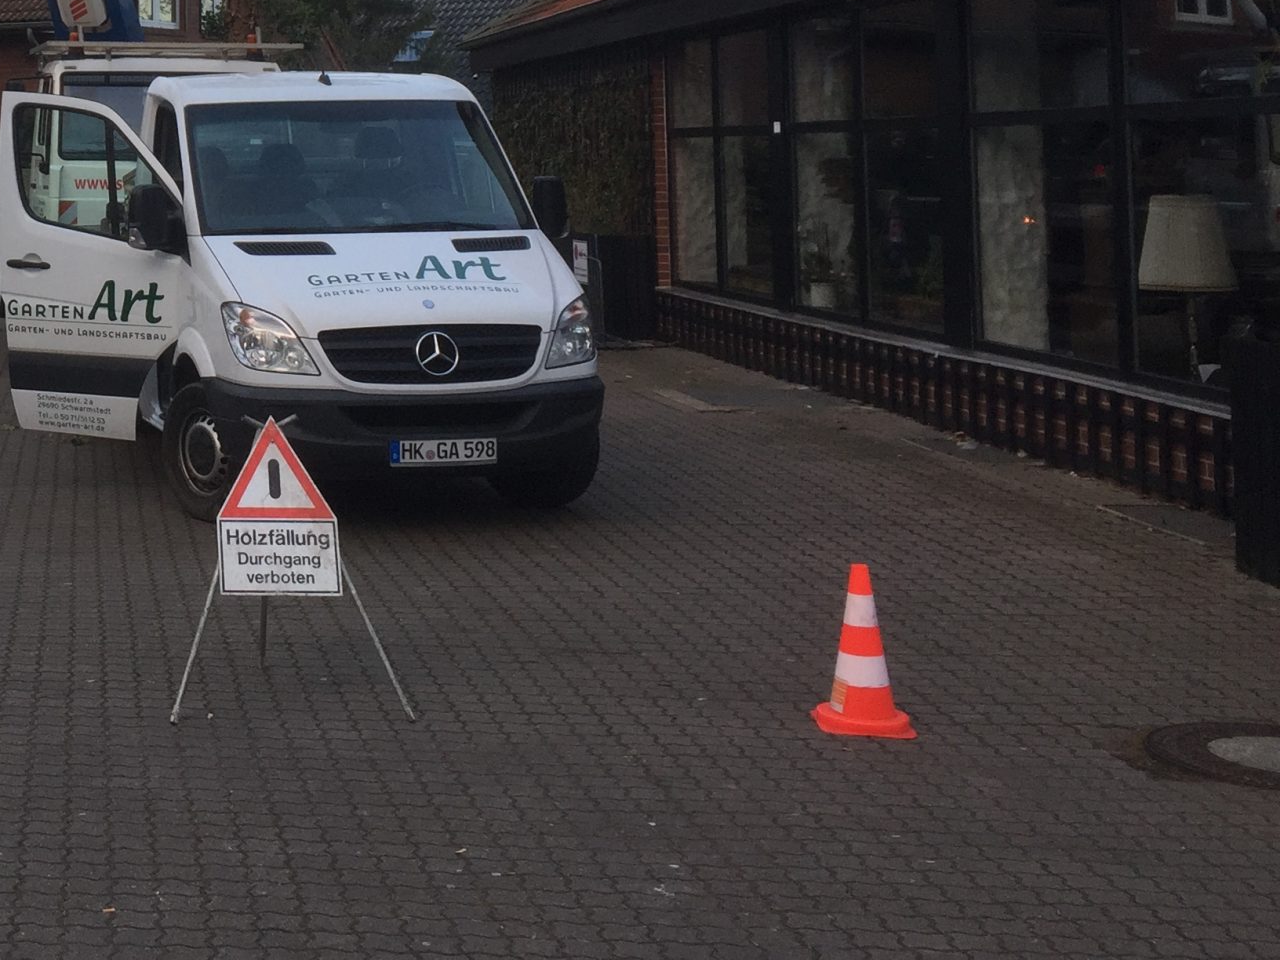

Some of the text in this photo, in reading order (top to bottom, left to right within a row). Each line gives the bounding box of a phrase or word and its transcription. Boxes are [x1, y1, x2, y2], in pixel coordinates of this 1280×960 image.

[307, 255, 507, 286] GARTEN Art
[7, 279, 165, 324] GARTEN Art
[401, 440, 496, 460] HK GA 598
[226, 529, 330, 550] Holzfällung
[237, 552, 321, 568] Durchgang
[247, 570, 315, 584] verboten
